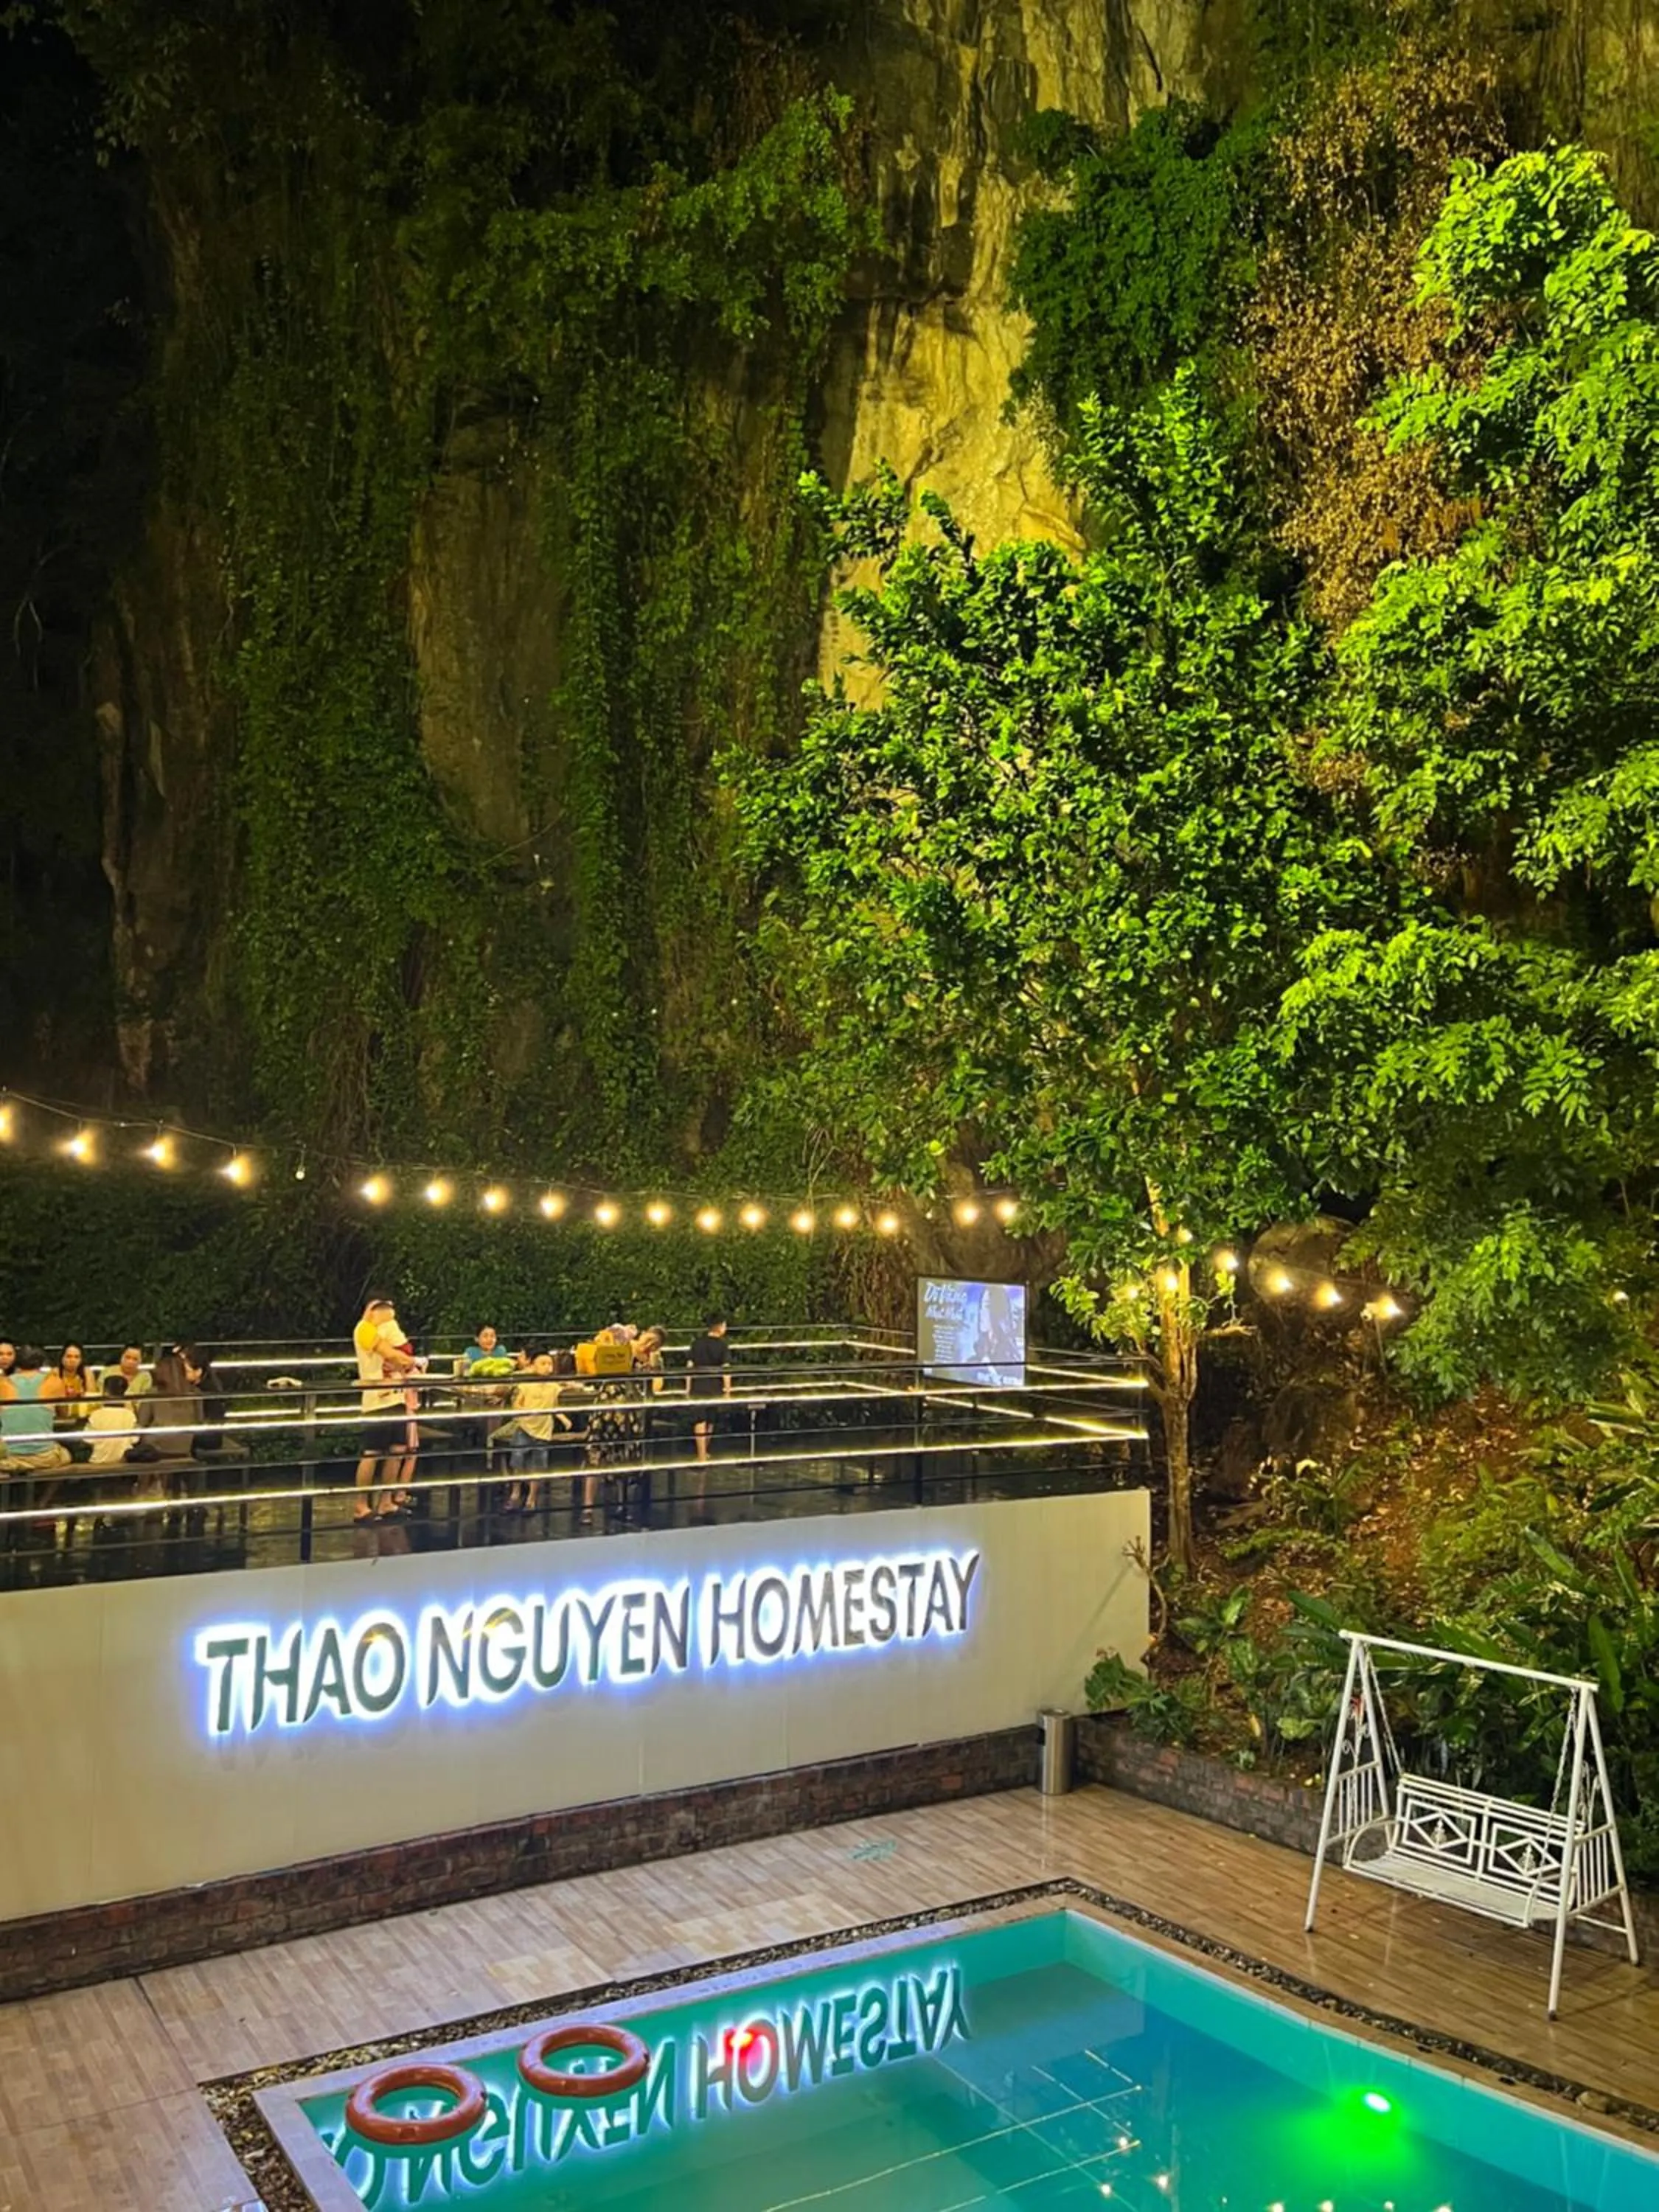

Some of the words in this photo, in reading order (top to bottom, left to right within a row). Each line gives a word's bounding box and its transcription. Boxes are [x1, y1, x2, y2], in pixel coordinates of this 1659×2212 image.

[206, 1622, 406, 1731] THAO
[422, 1586, 690, 1705] NGUYEN
[710, 1552, 981, 1665] HOMESTAY
